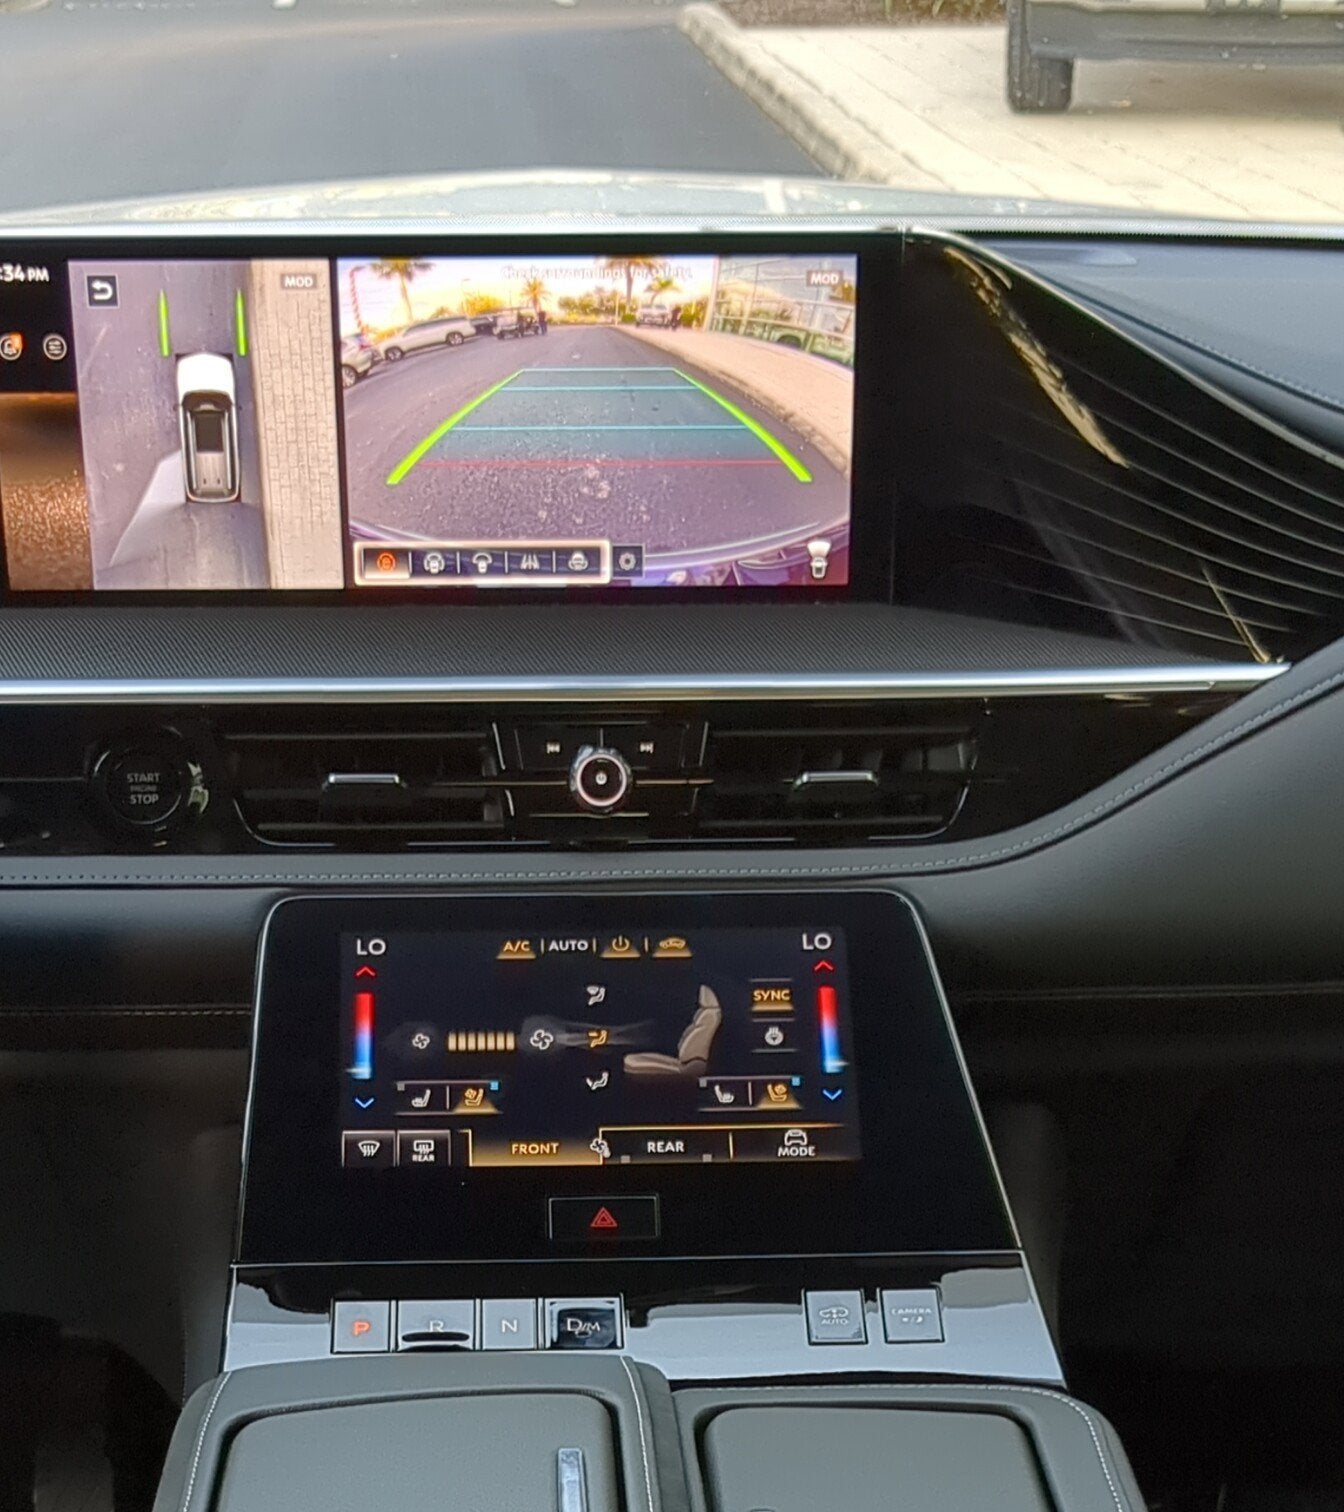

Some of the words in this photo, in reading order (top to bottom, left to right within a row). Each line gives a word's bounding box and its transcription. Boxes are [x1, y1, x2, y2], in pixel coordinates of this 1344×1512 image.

[27, 266, 50, 282] PM
[810, 273, 840, 286] MOD
[284, 275, 313, 288] MOD
[126, 772, 160, 783] START
[130, 794, 159, 805] STOP
[356, 938, 386, 956] LO
[503, 940, 531, 952] A/C
[548, 939, 589, 951] AUTO
[802, 933, 832, 951] LO
[752, 988, 791, 1002] SYNC
[511, 1142, 559, 1155] FRONT
[647, 1141, 685, 1153] REAR
[777, 1146, 816, 1158] MODE
[412, 1152, 435, 1162] REAR
[352, 1320, 371, 1336] P
[429, 1320, 444, 1333] R
[501, 1319, 518, 1333] N
